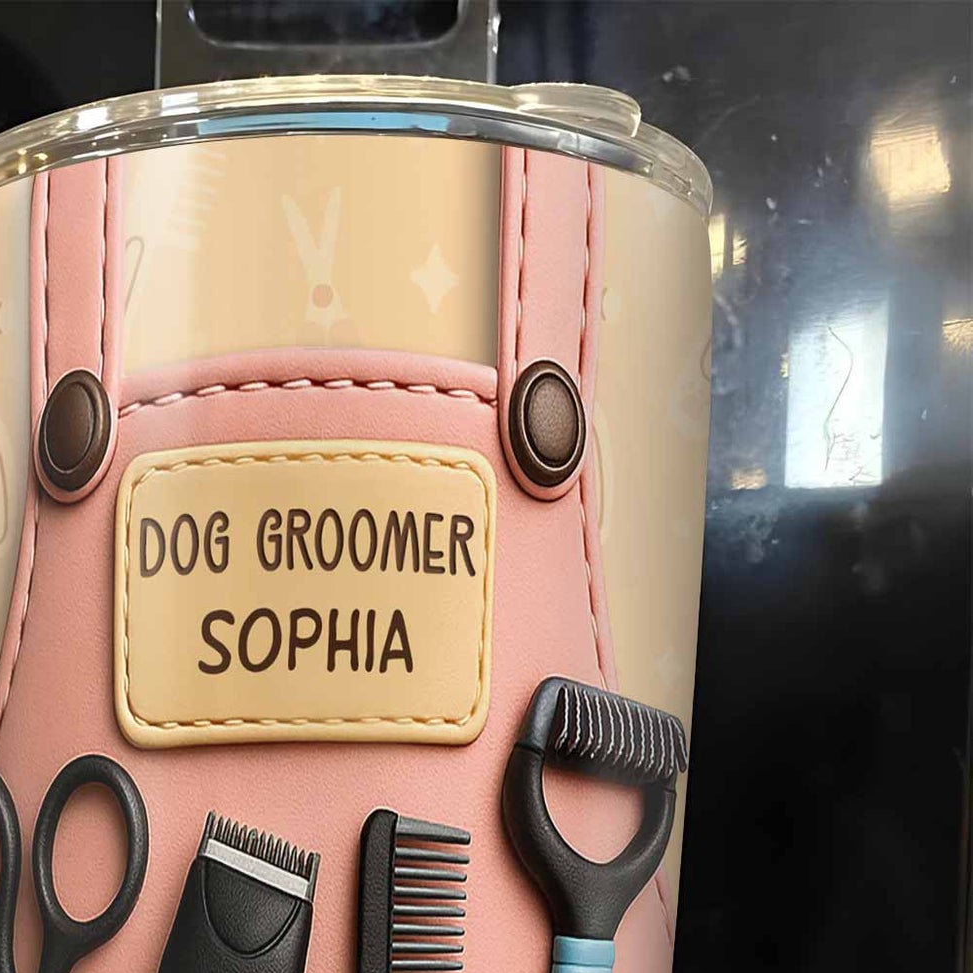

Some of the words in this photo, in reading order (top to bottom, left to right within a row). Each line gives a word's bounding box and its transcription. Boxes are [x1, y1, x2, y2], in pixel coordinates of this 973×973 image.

[139, 510, 230, 578] DOG
[256, 507, 476, 577] GROOMER
[197, 607, 414, 675] SOPHIA
